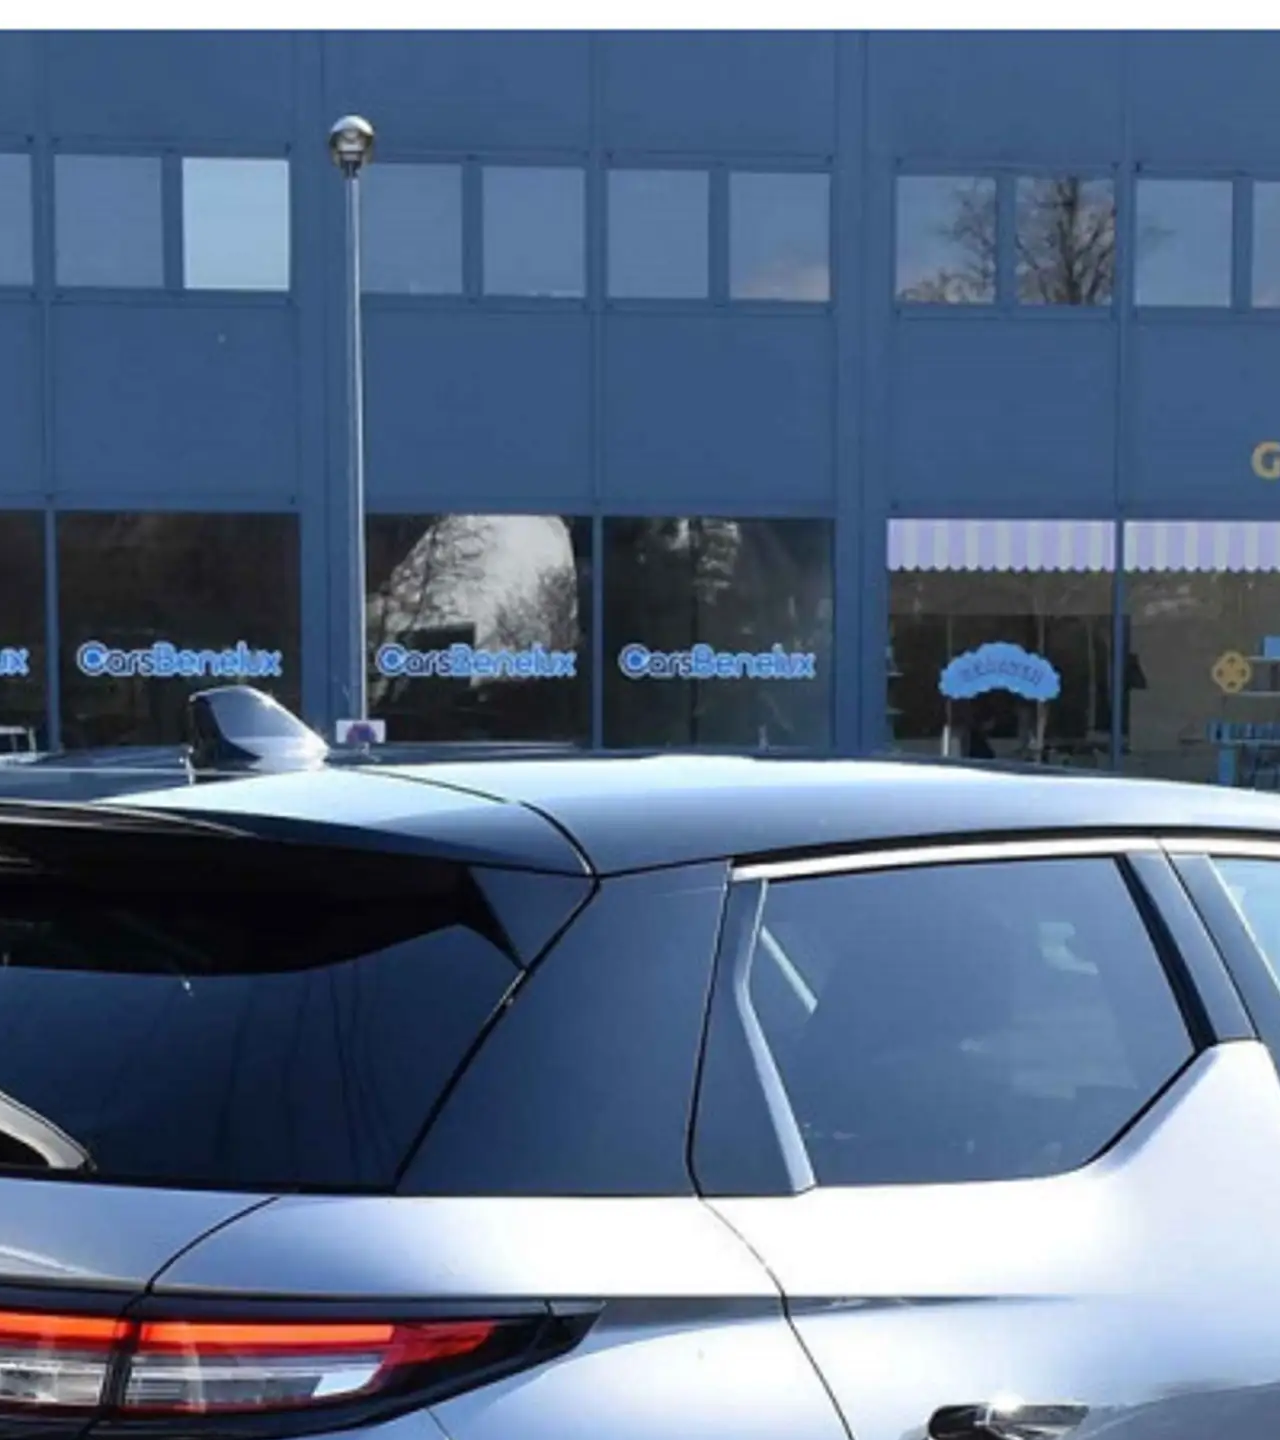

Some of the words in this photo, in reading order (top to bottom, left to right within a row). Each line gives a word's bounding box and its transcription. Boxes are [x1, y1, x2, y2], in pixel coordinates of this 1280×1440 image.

[76, 640, 283, 678] CarsBenelux
[376, 642, 577, 678] CarsBenelux
[619, 642, 817, 680] CarsBenelux
